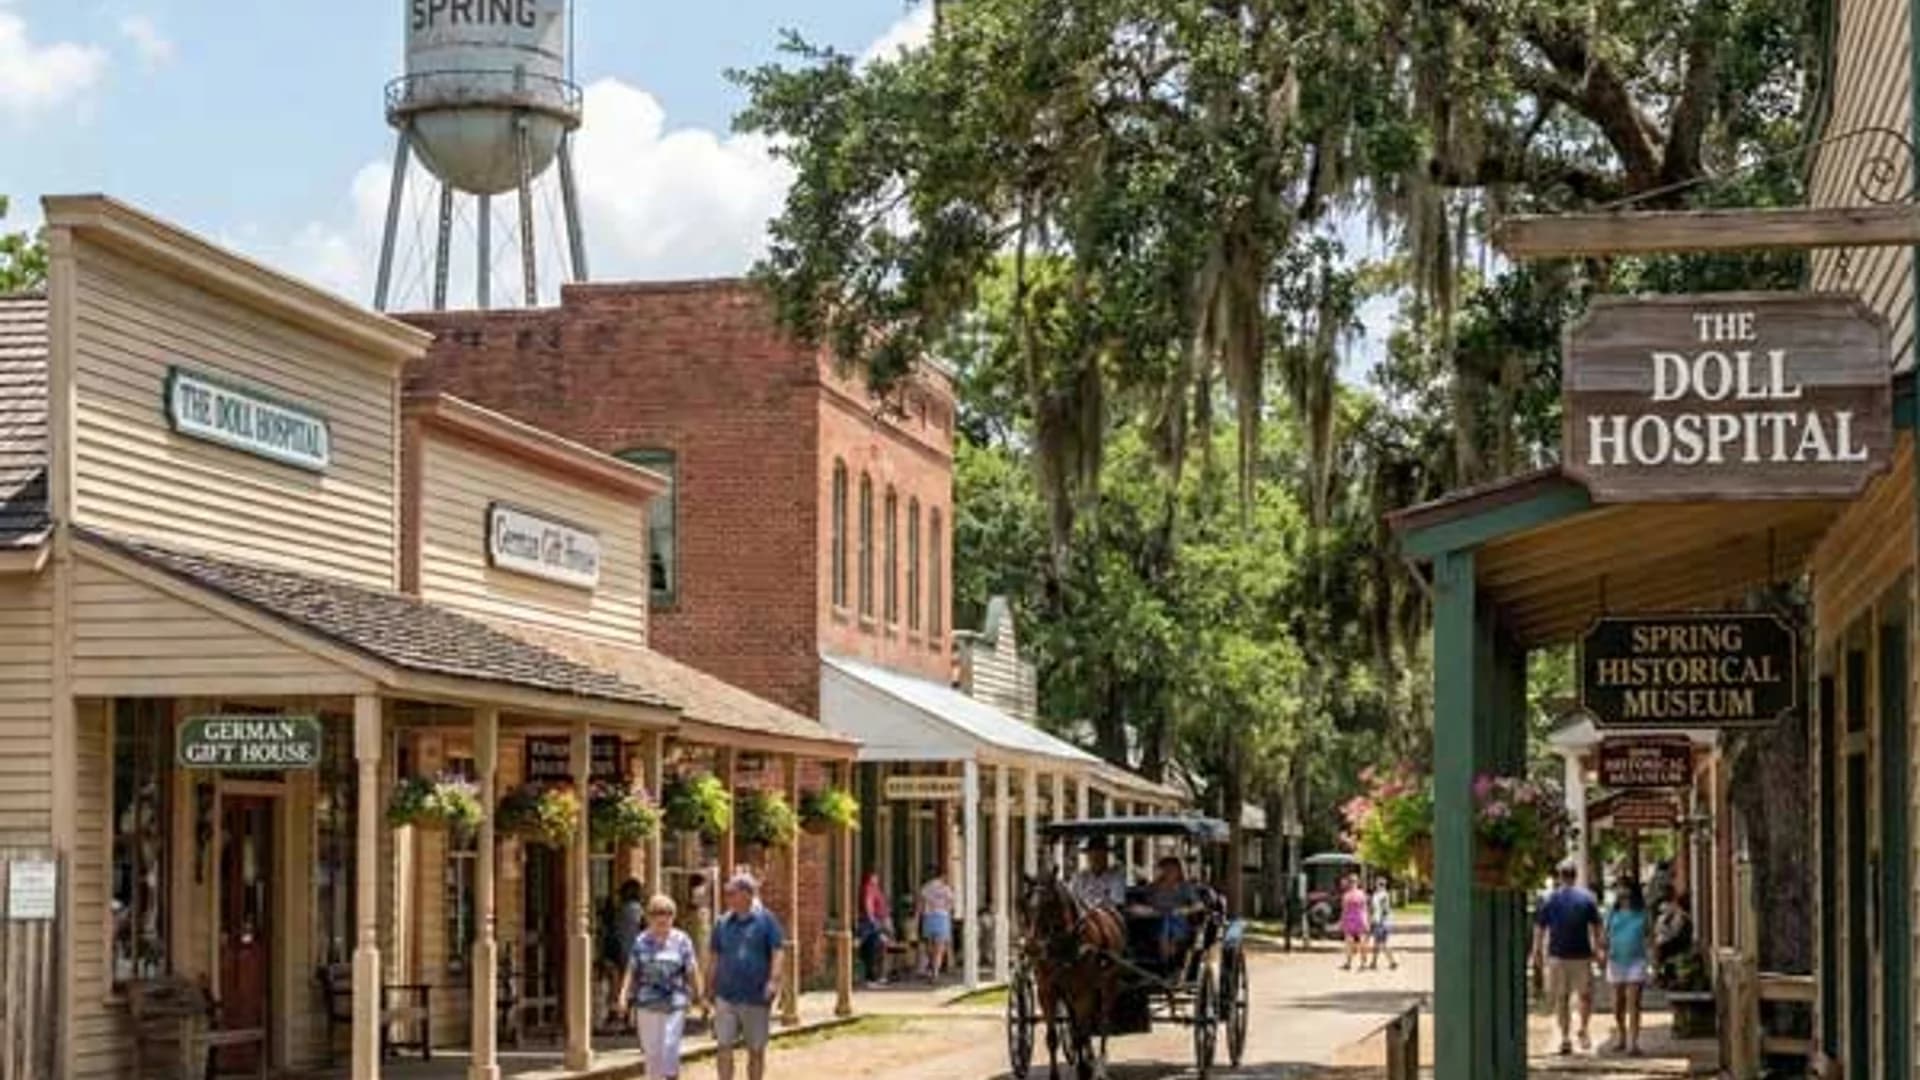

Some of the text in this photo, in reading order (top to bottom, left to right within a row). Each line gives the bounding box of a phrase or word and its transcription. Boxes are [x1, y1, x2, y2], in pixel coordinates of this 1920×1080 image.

[1694, 312, 1757, 341] THE
[1653, 350, 1803, 400] DOLL
[180, 383, 212, 426] THE
[1588, 410, 1868, 465] HOSPITAL
[1632, 624, 1743, 652] SPRING
[1598, 656, 1780, 685] HISTORICAL
[1623, 688, 1755, 717] MUSEUM
[204, 722, 294, 740] GERMAN
[186, 742, 312, 762] GIFT HOUSE
